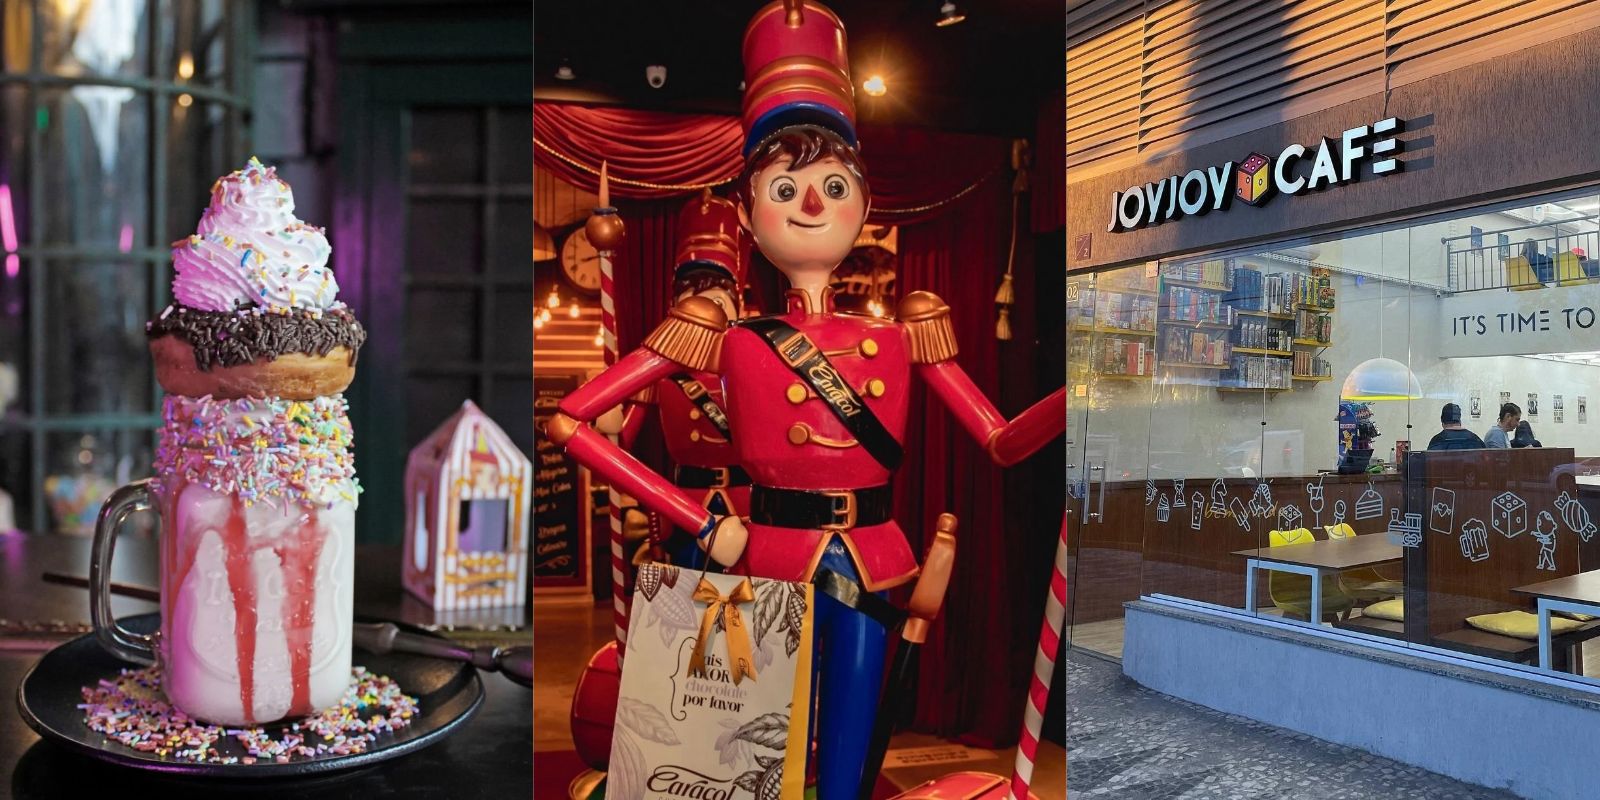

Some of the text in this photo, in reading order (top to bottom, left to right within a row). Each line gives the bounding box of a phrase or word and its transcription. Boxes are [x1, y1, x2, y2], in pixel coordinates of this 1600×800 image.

[1107, 117, 1397, 232] JOYJOY CAFE
[1453, 307, 1596, 336] IT'S TIME TO
[809, 362, 862, 416] Caracol
[703, 654, 723, 667] ais
[682, 694, 745, 712] por favor
[685, 680, 748, 698] chocolate
[647, 765, 738, 800] Caracol
